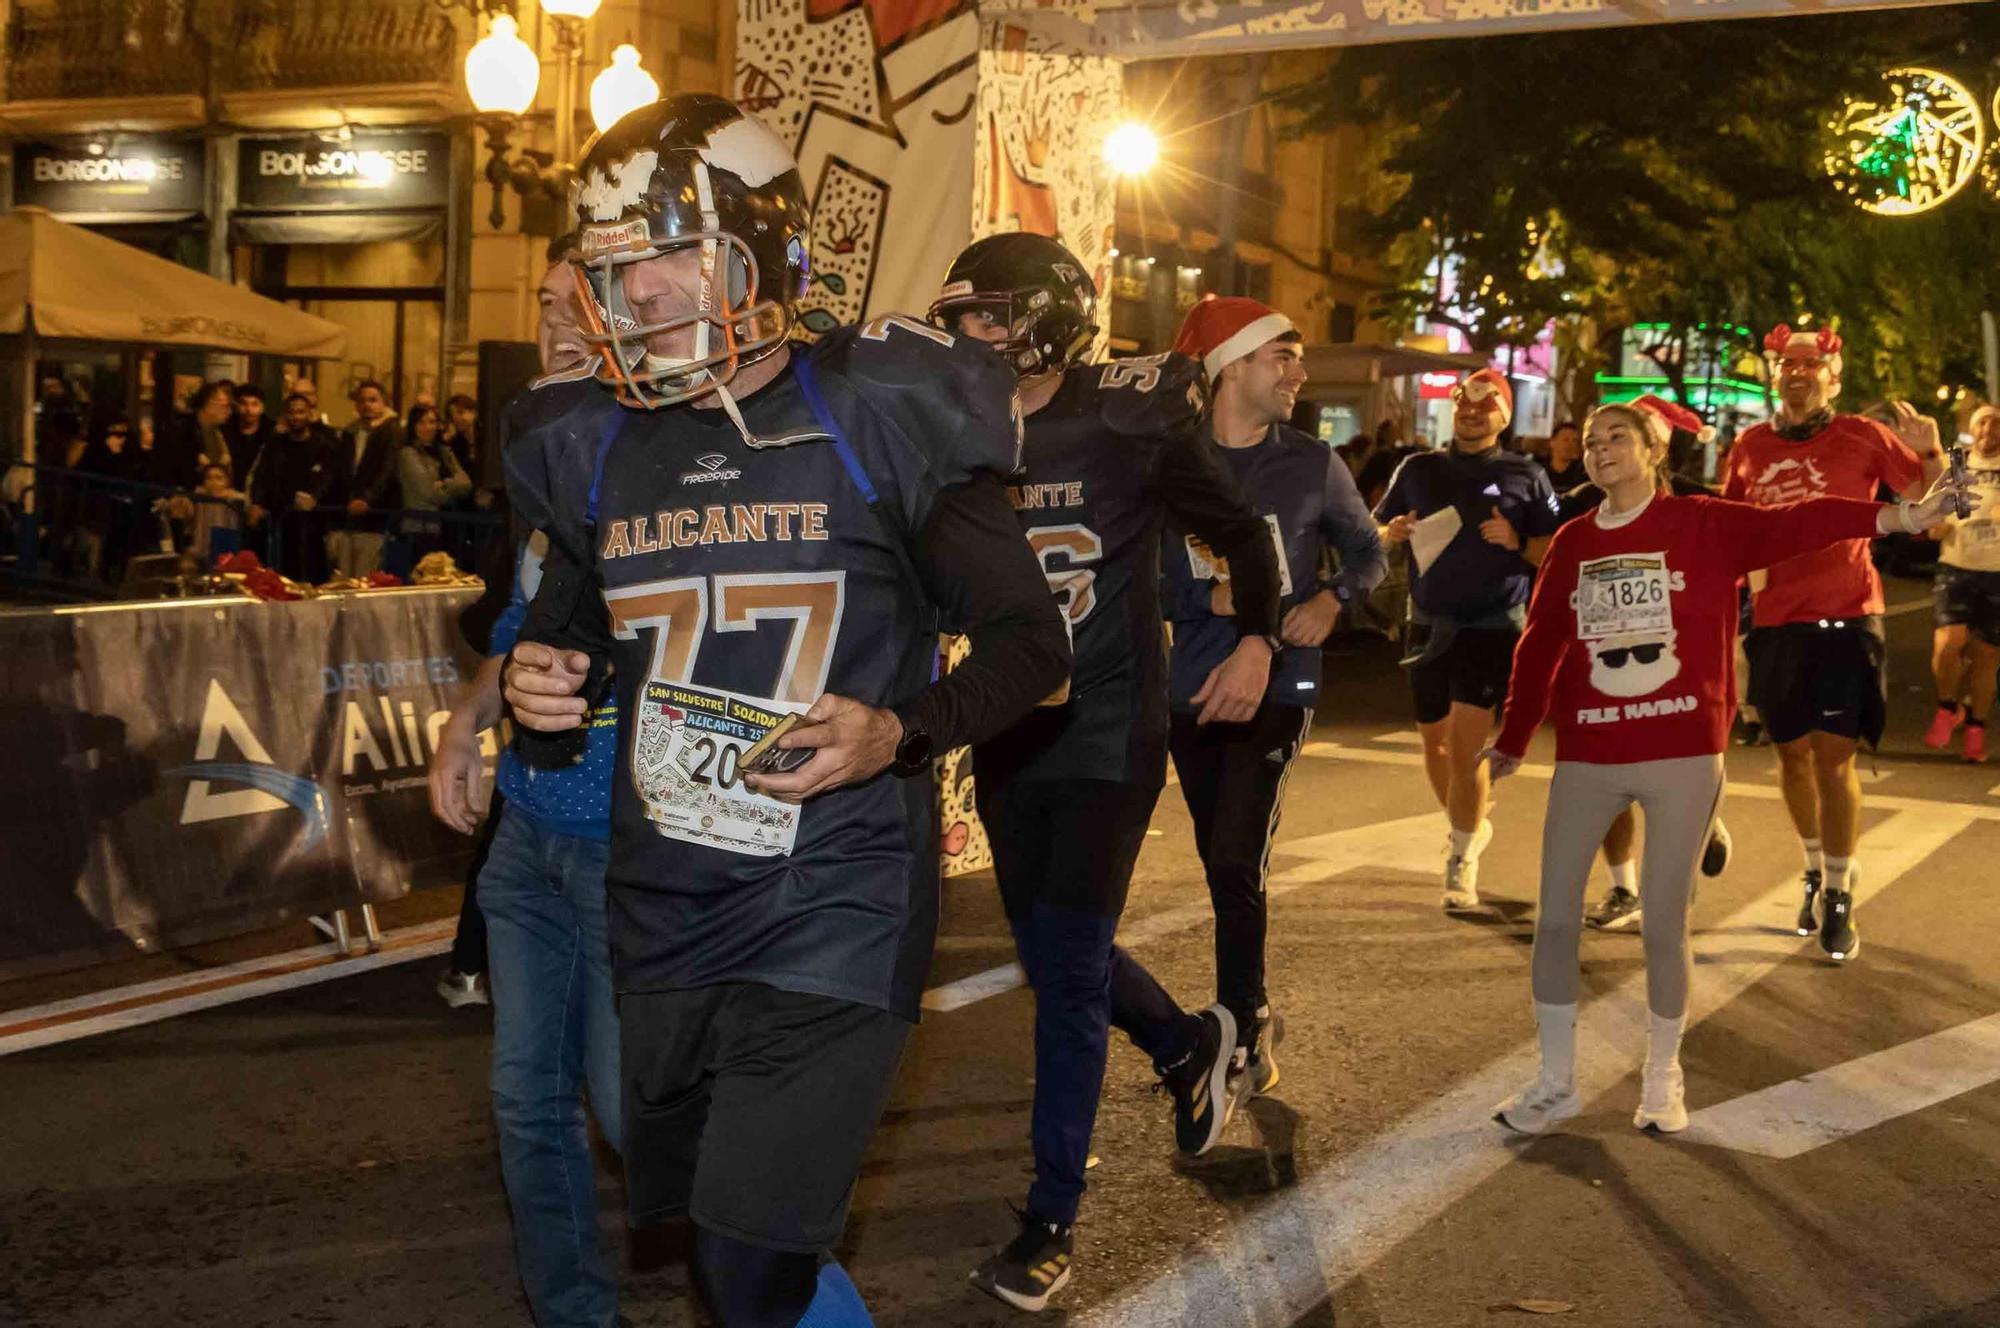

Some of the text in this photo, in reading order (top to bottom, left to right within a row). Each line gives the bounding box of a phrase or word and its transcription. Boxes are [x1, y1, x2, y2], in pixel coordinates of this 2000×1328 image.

[34, 157, 183, 181] BORGONSE
[260, 150, 428, 176] BOGONSSE
[596, 226, 631, 246] Riddel
[603, 503, 829, 560] ALICANTE
[1607, 577, 1664, 607] 1826
[603, 569, 847, 702] 77
[320, 656, 459, 694] DEPORTES
[649, 685, 782, 728] SAN SILVESTRE SOLIDA
[1623, 696, 1698, 720] NAVIDAD
[686, 712, 746, 737] ALICANTE
